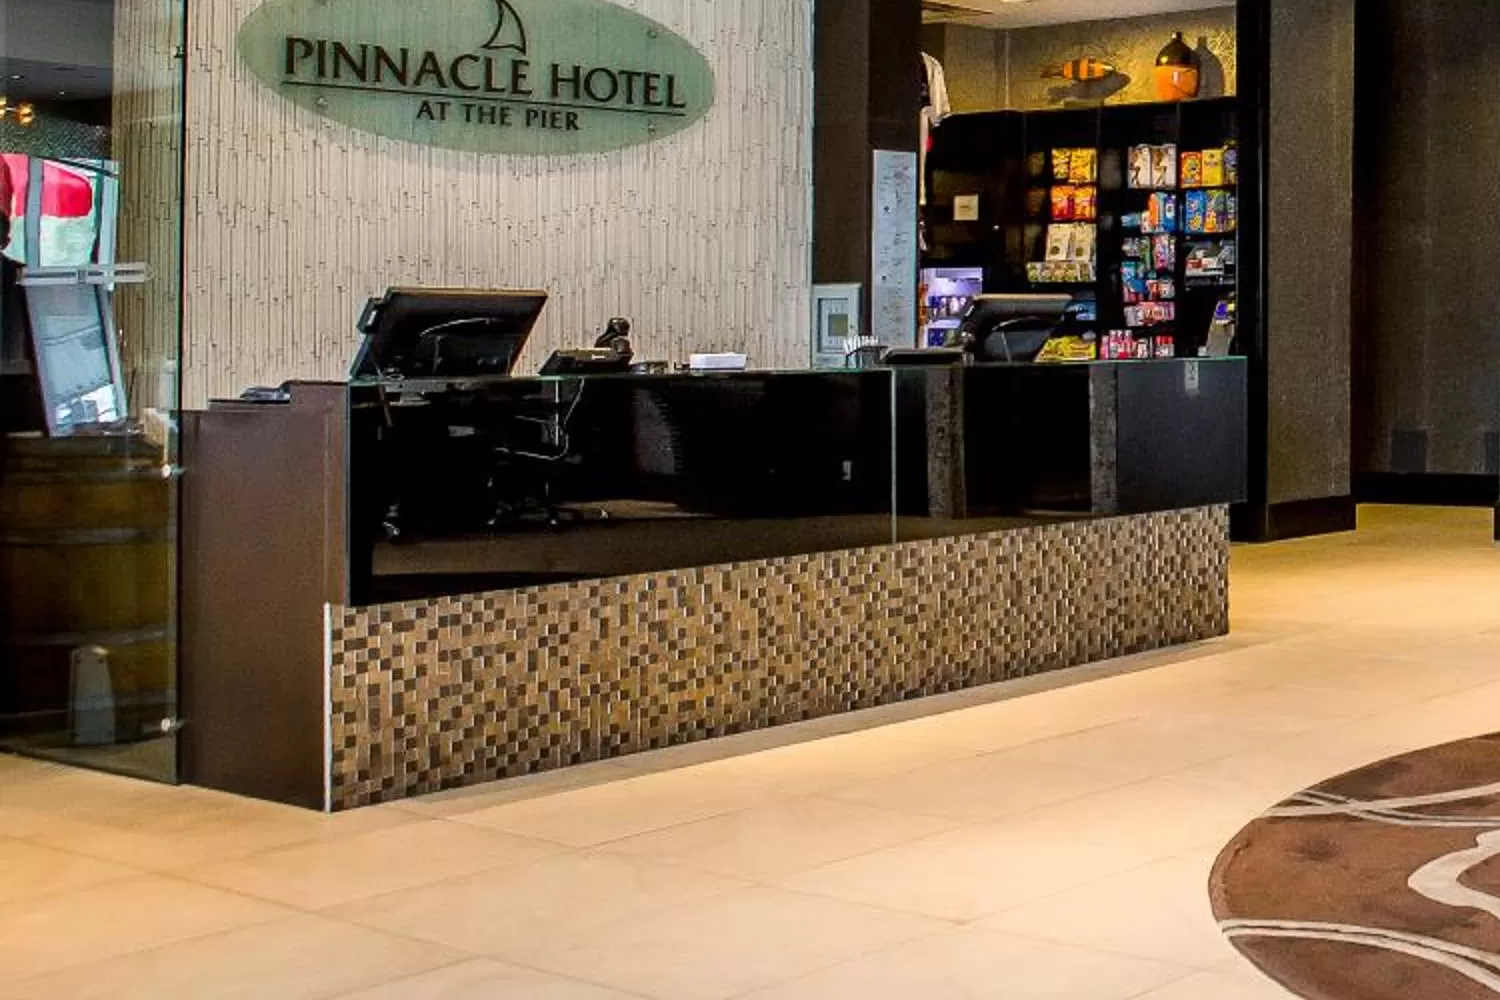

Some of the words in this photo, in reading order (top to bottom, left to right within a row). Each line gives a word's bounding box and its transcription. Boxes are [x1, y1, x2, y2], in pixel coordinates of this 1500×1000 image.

[284, 36, 533, 96] PINNACLE
[551, 63, 687, 110] HOTEL
[416, 100, 451, 121] AT
[463, 103, 513, 127] THE
[525, 108, 581, 131] PIER
